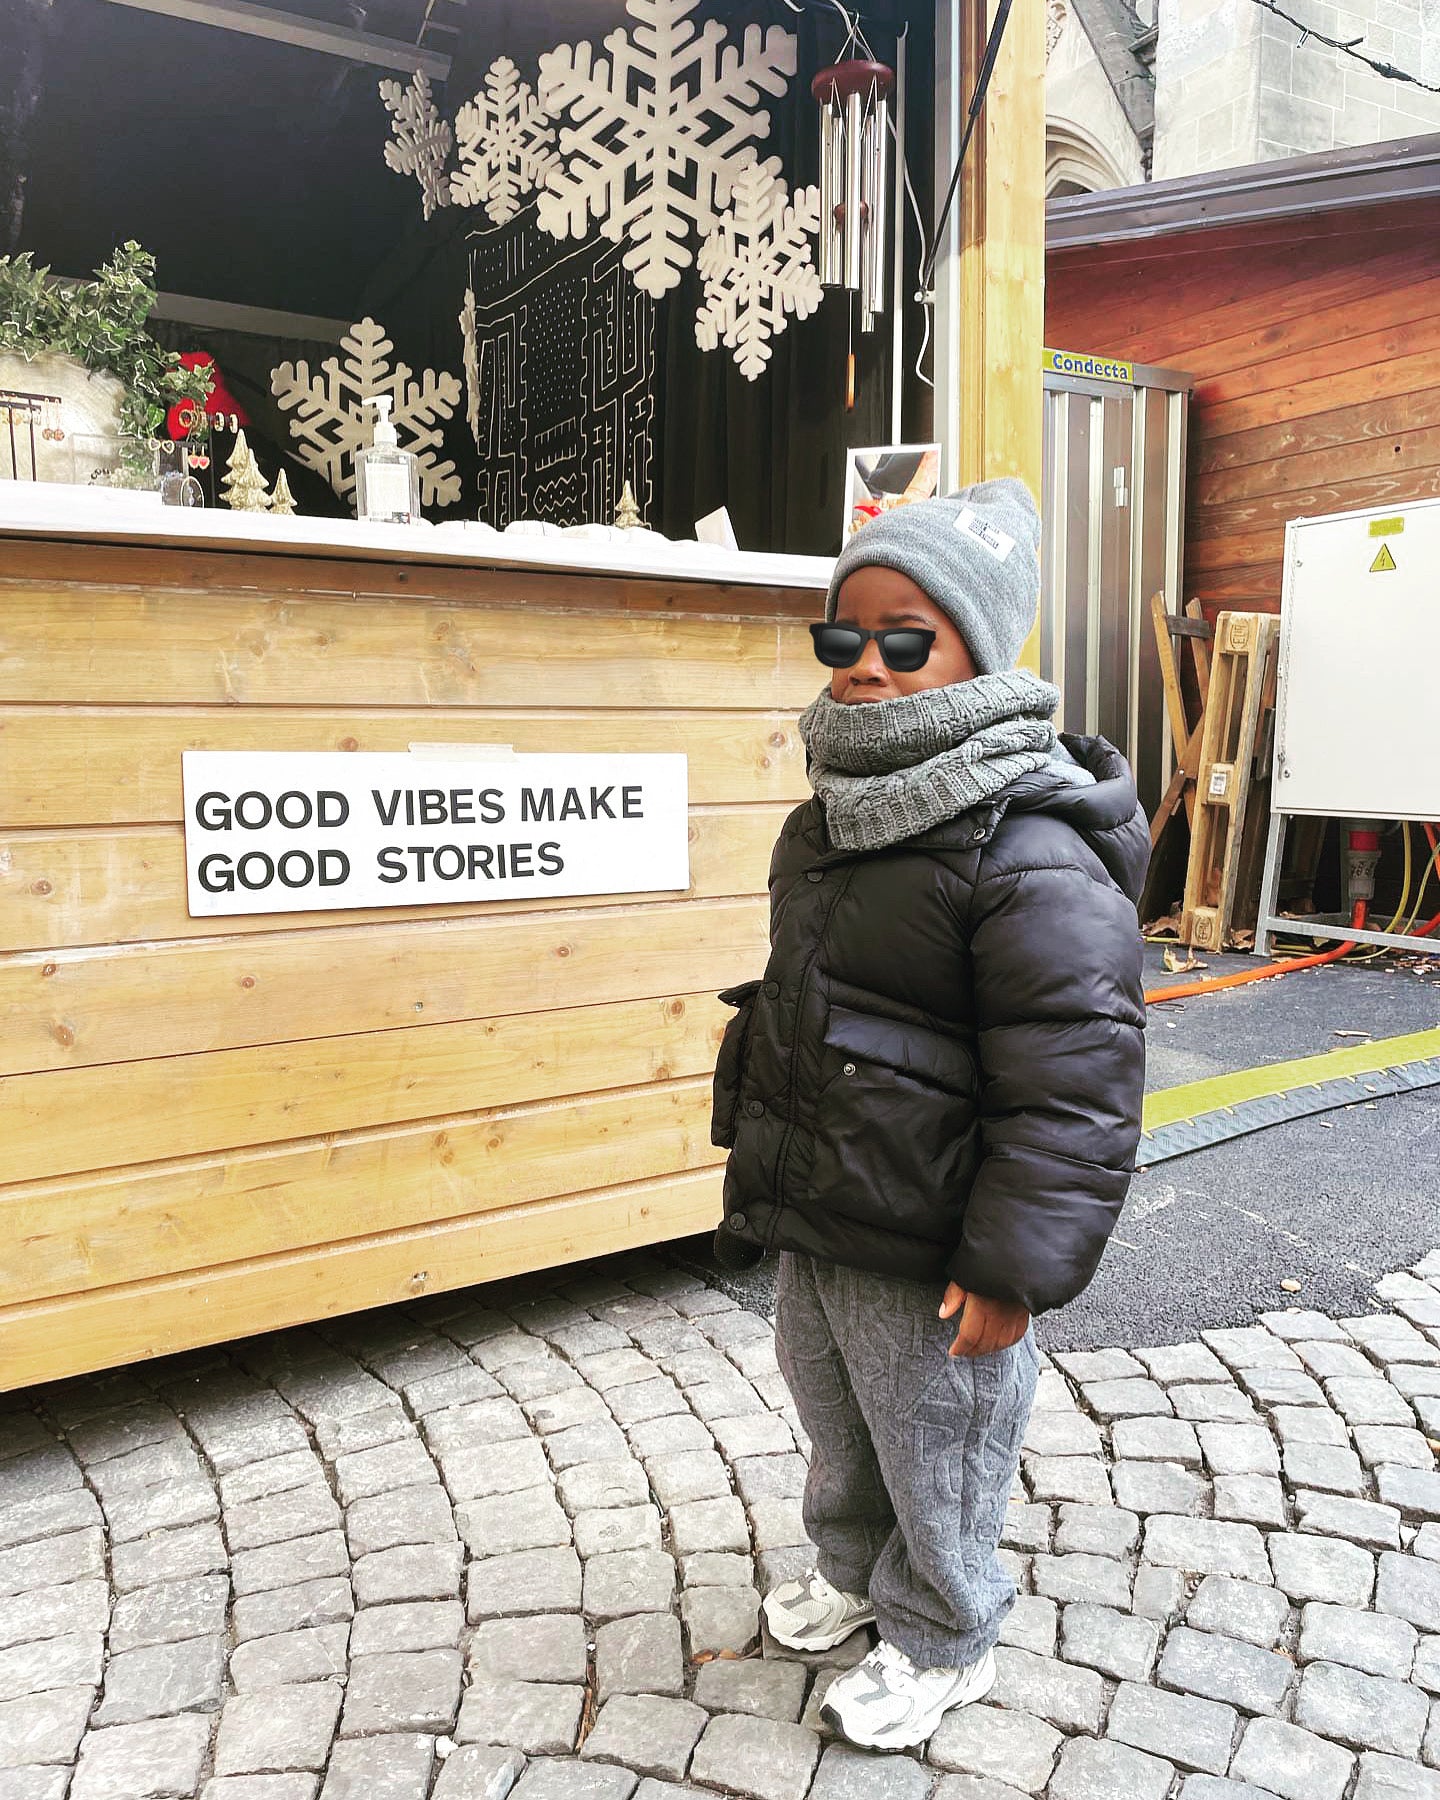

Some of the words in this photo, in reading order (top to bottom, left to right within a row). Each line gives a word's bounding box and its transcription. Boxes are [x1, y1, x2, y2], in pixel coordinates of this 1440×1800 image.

[1053, 353, 1128, 379] Condecta
[196, 790, 350, 830] GOOD
[371, 788, 506, 826] VIBES
[521, 785, 645, 822] MAKE
[197, 849, 351, 892] GOOD
[376, 841, 565, 884] STORIES
